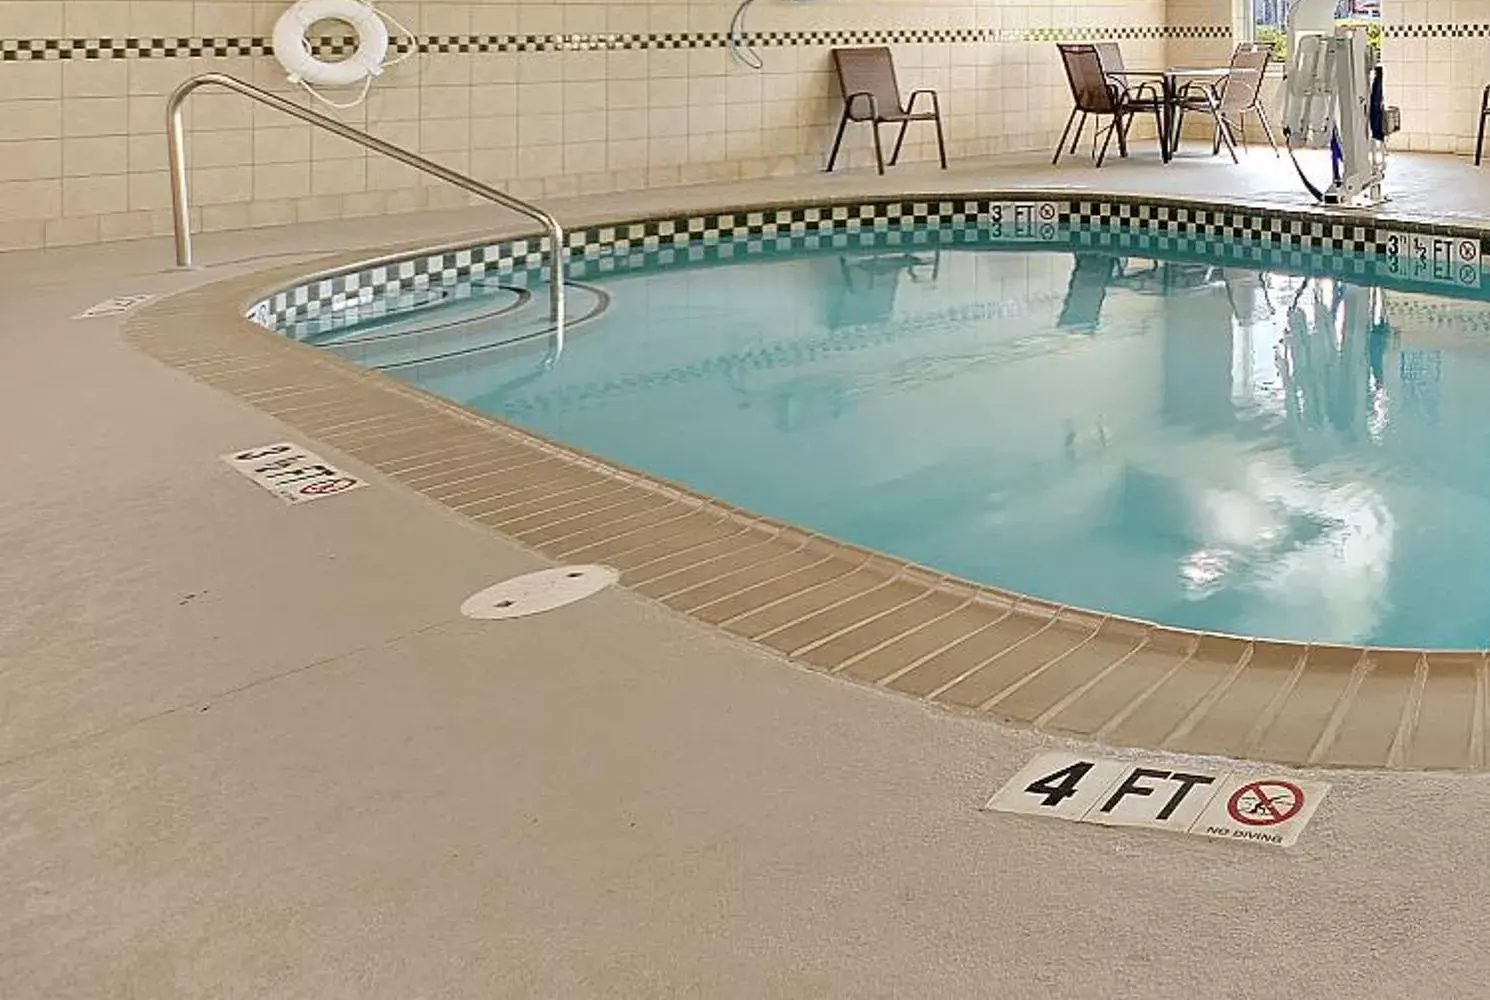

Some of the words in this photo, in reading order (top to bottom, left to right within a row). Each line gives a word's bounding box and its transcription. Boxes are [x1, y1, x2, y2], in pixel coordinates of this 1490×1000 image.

[992, 205, 1002, 222] 3
[1015, 205, 1035, 223] FT
[1433, 240, 1453, 261] FT
[1024, 760, 1096, 807] 4
[1100, 767, 1217, 820] FT
[1207, 826, 1230, 836] NO
[1233, 829, 1283, 843] DIVING
